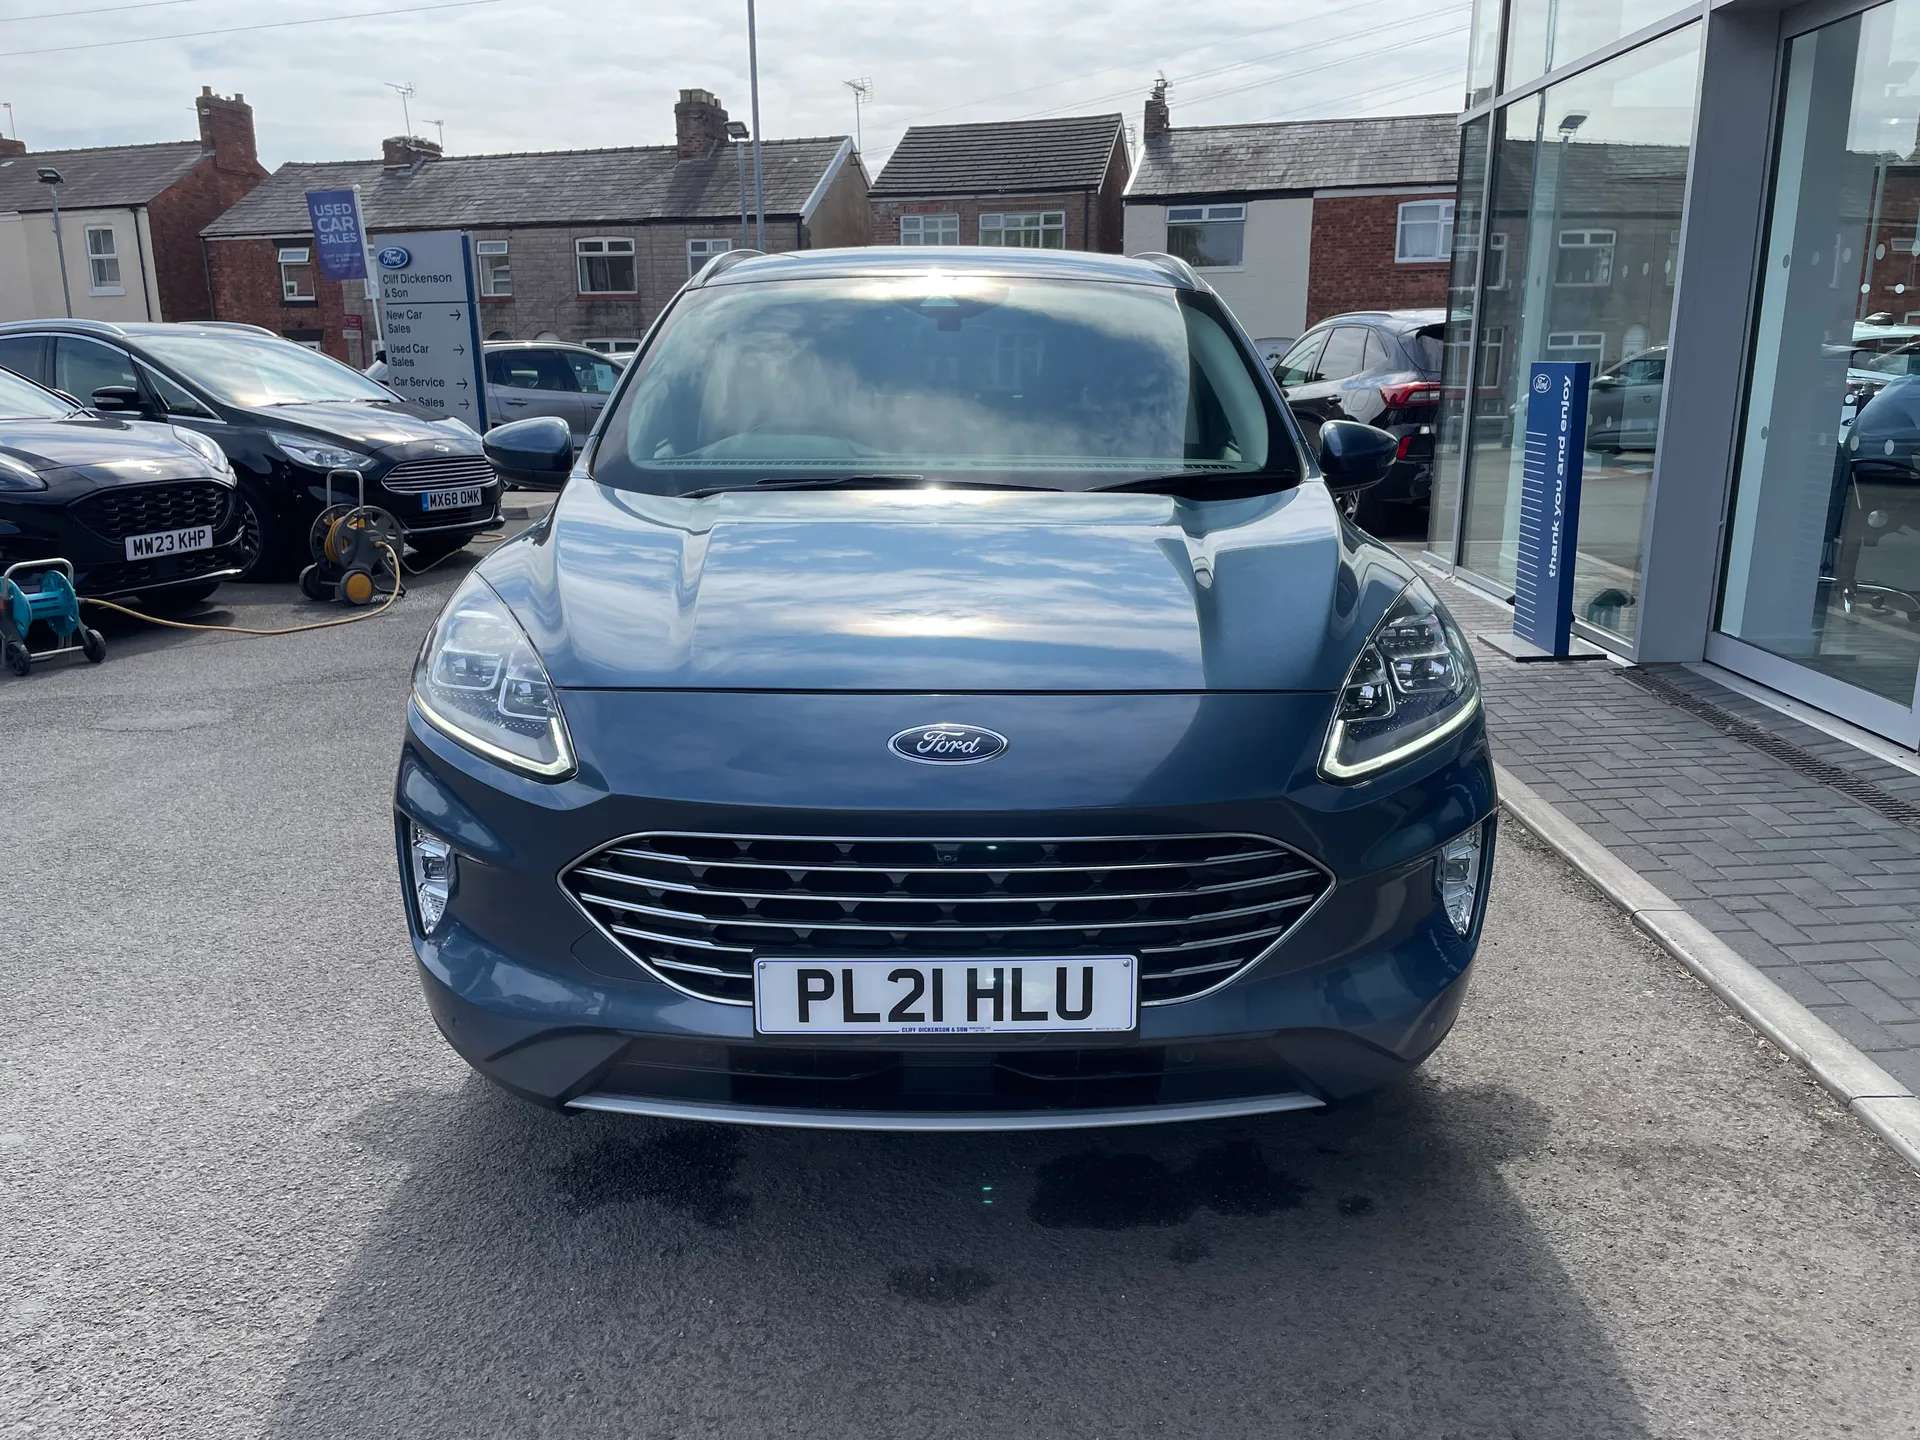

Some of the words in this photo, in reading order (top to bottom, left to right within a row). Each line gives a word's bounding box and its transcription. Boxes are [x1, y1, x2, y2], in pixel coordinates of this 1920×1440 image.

[314, 203, 352, 217] USED
[317, 216, 355, 233] CAR
[320, 233, 358, 245] SALES
[383, 251, 402, 265] Ford
[383, 274, 399, 285] Cliff
[400, 273, 452, 284] Dickenson
[384, 289, 390, 298] &
[391, 288, 409, 298] Son
[386, 310, 405, 320] New
[406, 309, 423, 320] Car
[388, 323, 411, 334] Sales
[390, 344, 411, 354] Used
[412, 343, 429, 354] Car
[391, 357, 415, 367] Sales
[393, 376, 409, 386] Car
[409, 376, 445, 387] Service
[418, 396, 445, 408] Sales
[1560, 375, 1571, 432] enjoy
[1557, 436, 1566, 476] and
[429, 491, 458, 508] MX68
[460, 489, 480, 505] OMK
[1554, 479, 1563, 517] you
[133, 534, 175, 556] MW23
[178, 529, 206, 549] KHP
[1548, 520, 1560, 578] thank
[916, 730, 981, 753] Ford
[797, 967, 944, 1023] PL21
[966, 966, 1094, 1022] HLU
